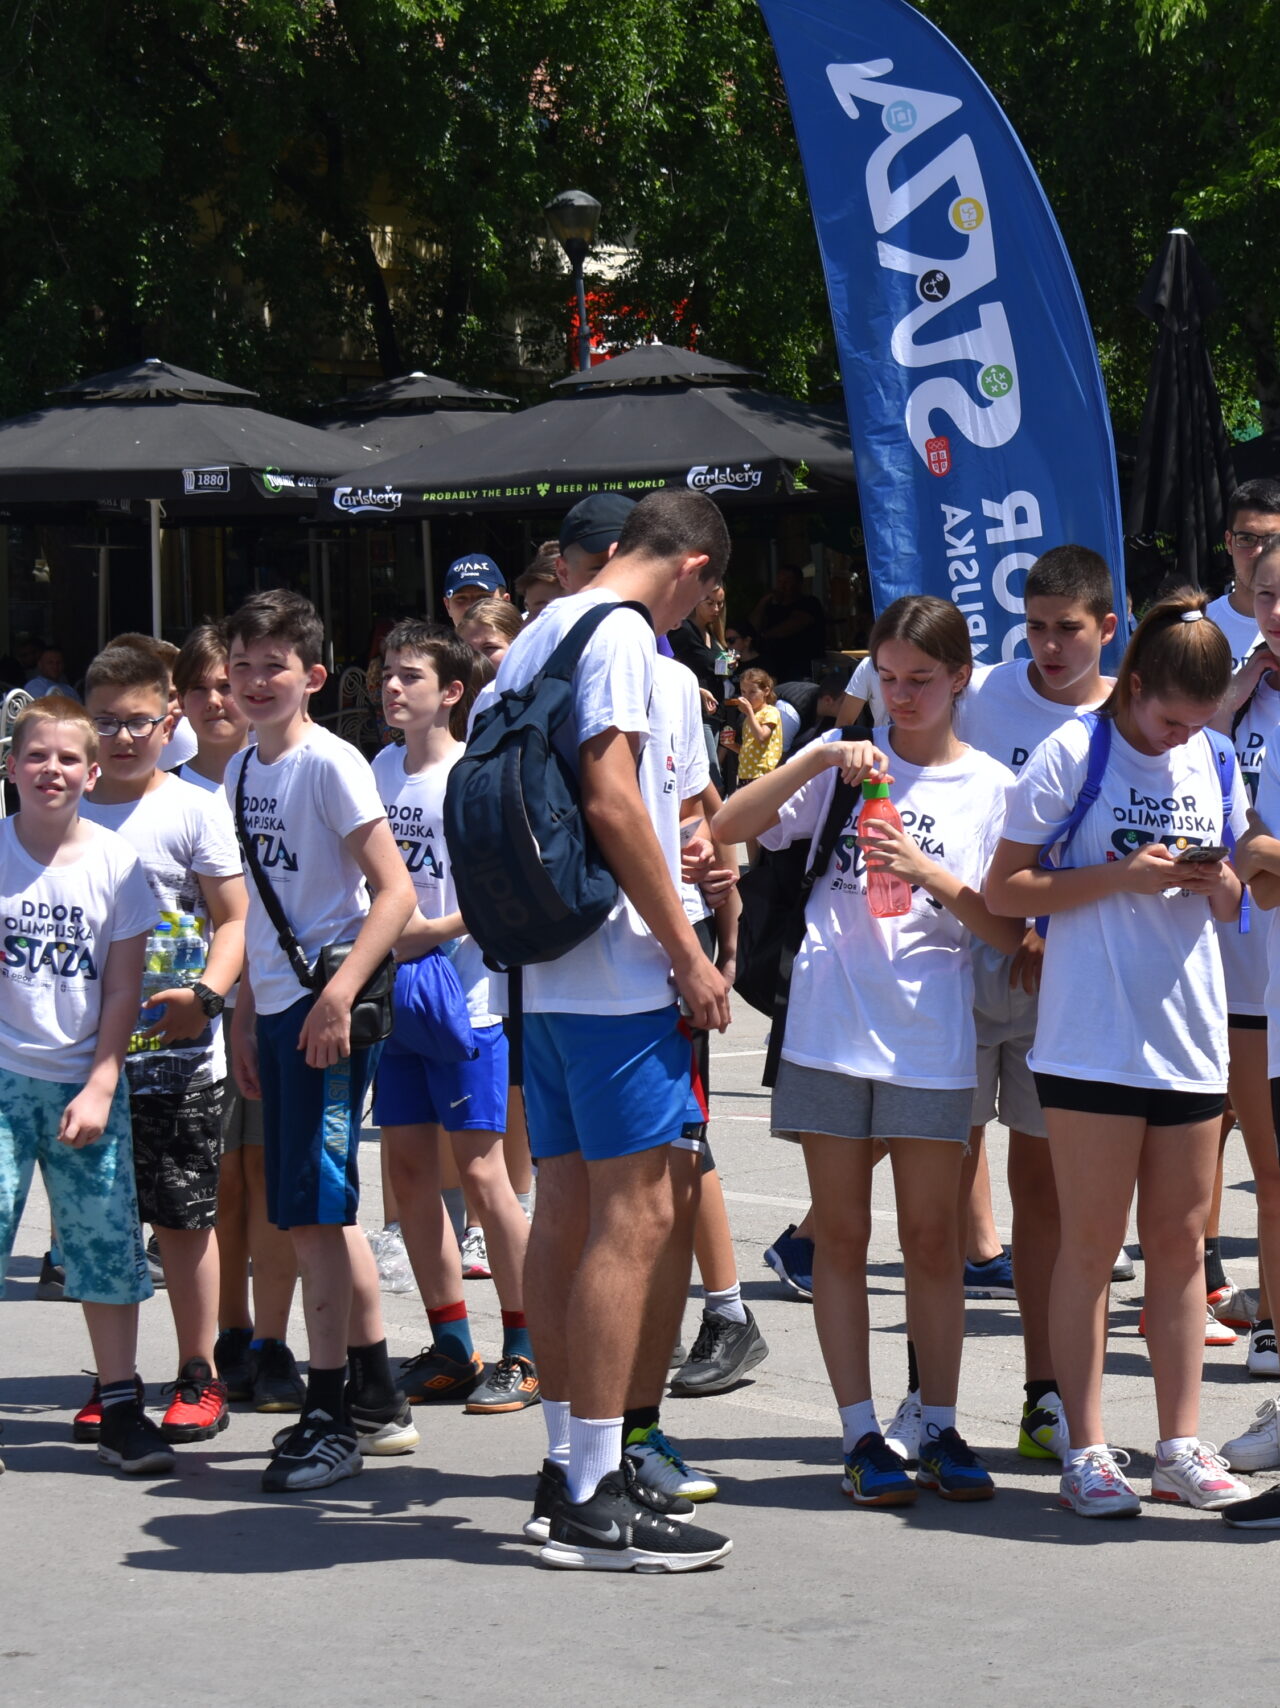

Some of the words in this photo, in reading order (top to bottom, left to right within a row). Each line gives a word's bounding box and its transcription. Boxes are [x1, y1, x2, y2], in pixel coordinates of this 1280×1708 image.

[196, 473, 225, 487] 1880
[423, 490, 478, 501] PROBABLY
[482, 488, 501, 498] THE
[506, 486, 532, 497] BEST
[556, 483, 582, 493] BEER
[588, 482, 599, 492] IN
[603, 480, 624, 491] THE
[628, 478, 667, 490] WORLD
[686, 464, 763, 494] Carlsberg
[333, 485, 403, 513] Carlsberg
[384, 804, 424, 823] DOR
[1112, 807, 1217, 833] OLIMPIJSKA
[21, 899, 85, 924] DDOR
[4, 916, 95, 942] OLIMPIJSKA
[3, 934, 99, 982] STAZA
